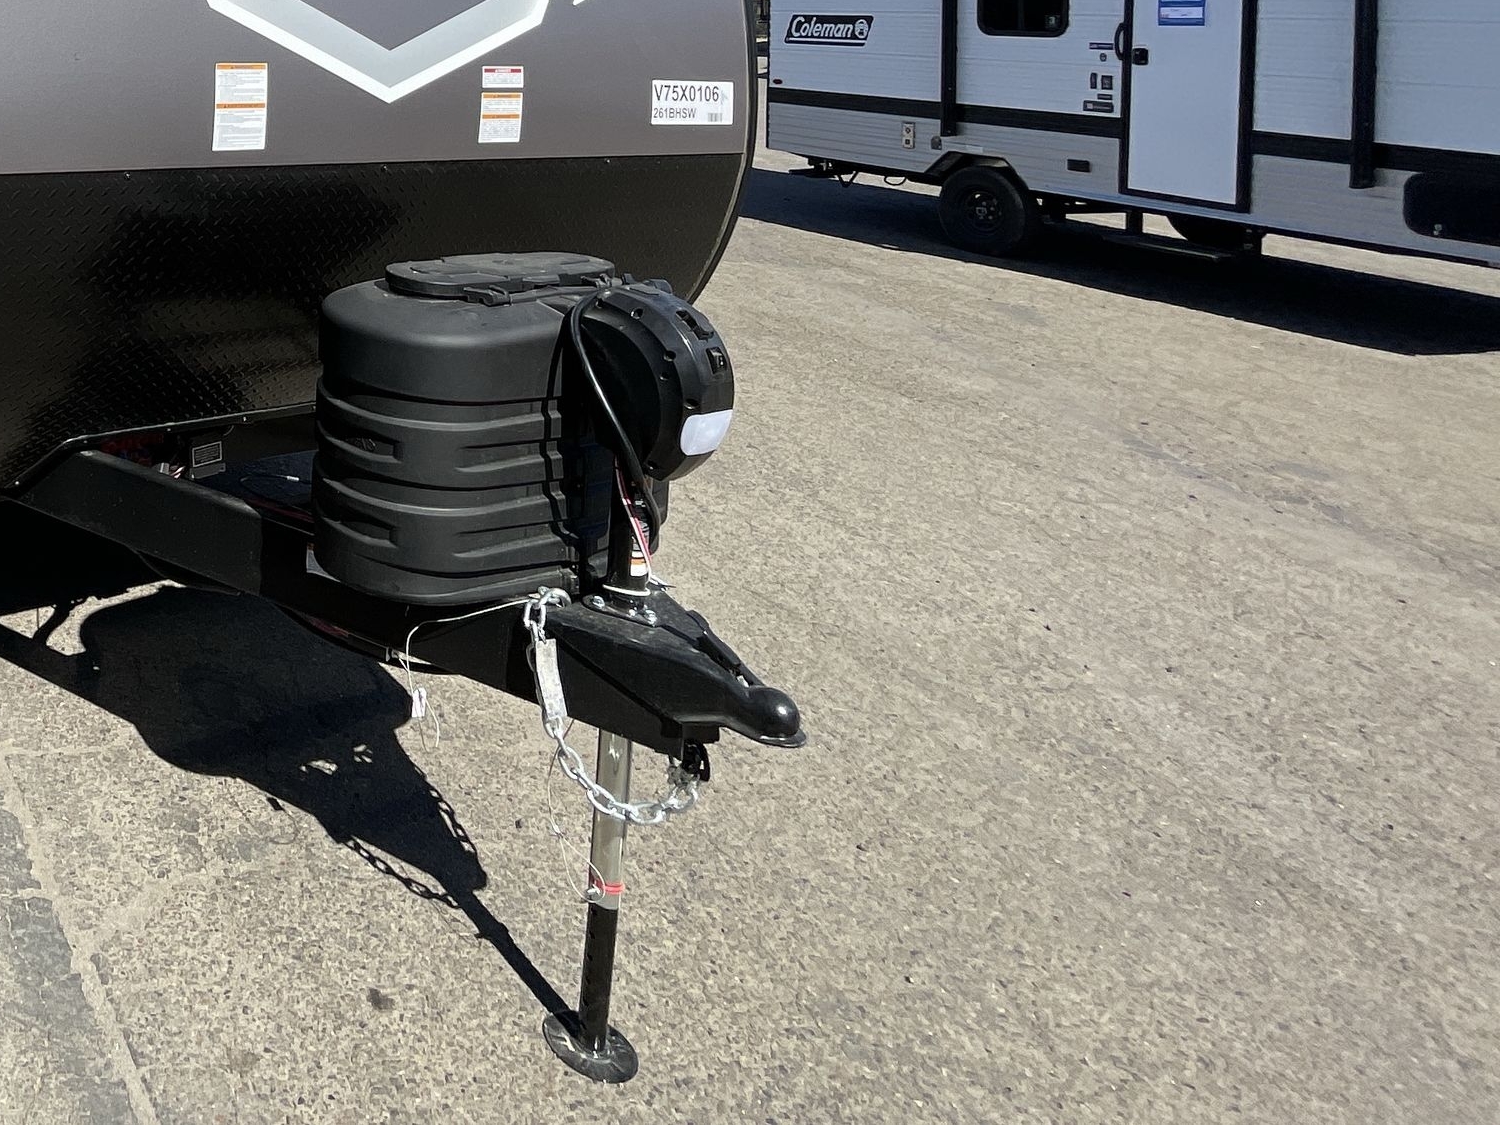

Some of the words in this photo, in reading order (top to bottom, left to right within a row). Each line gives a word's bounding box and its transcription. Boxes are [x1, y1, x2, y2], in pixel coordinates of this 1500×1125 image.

[791, 16, 854, 37] Coleman
[653, 84, 720, 102] V75X0106
[653, 107, 697, 119] 261BHSW
